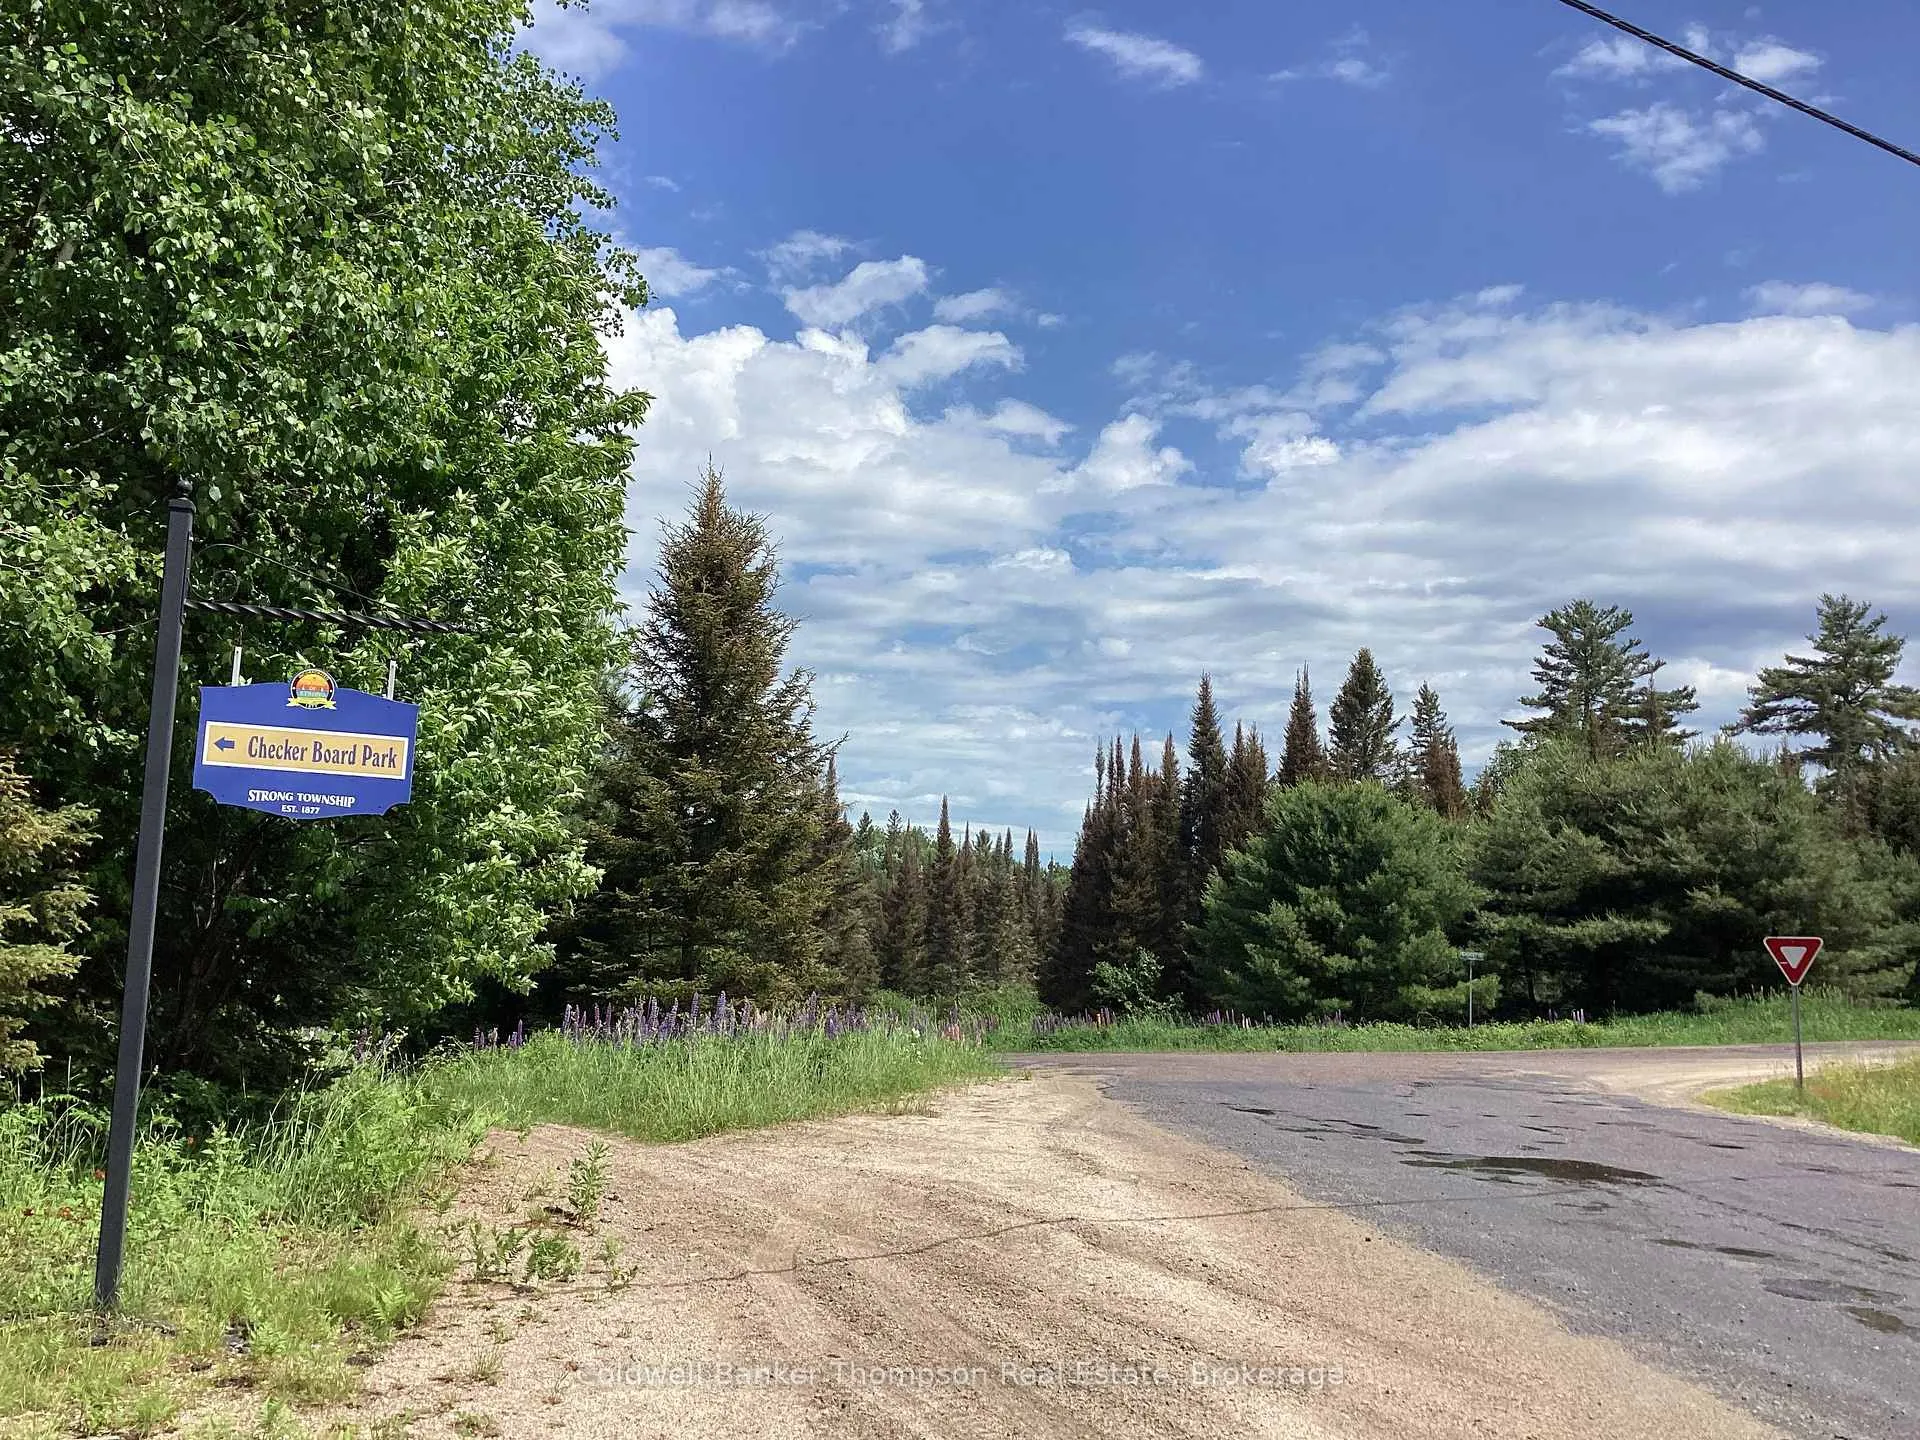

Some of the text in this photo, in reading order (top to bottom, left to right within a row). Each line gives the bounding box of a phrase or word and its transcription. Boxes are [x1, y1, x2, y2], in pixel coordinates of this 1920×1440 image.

[248, 736, 398, 768] Checker Board Park
[248, 789, 356, 808] STRONG TOWNSHIP
[281, 804, 320, 814] EST. 1877
